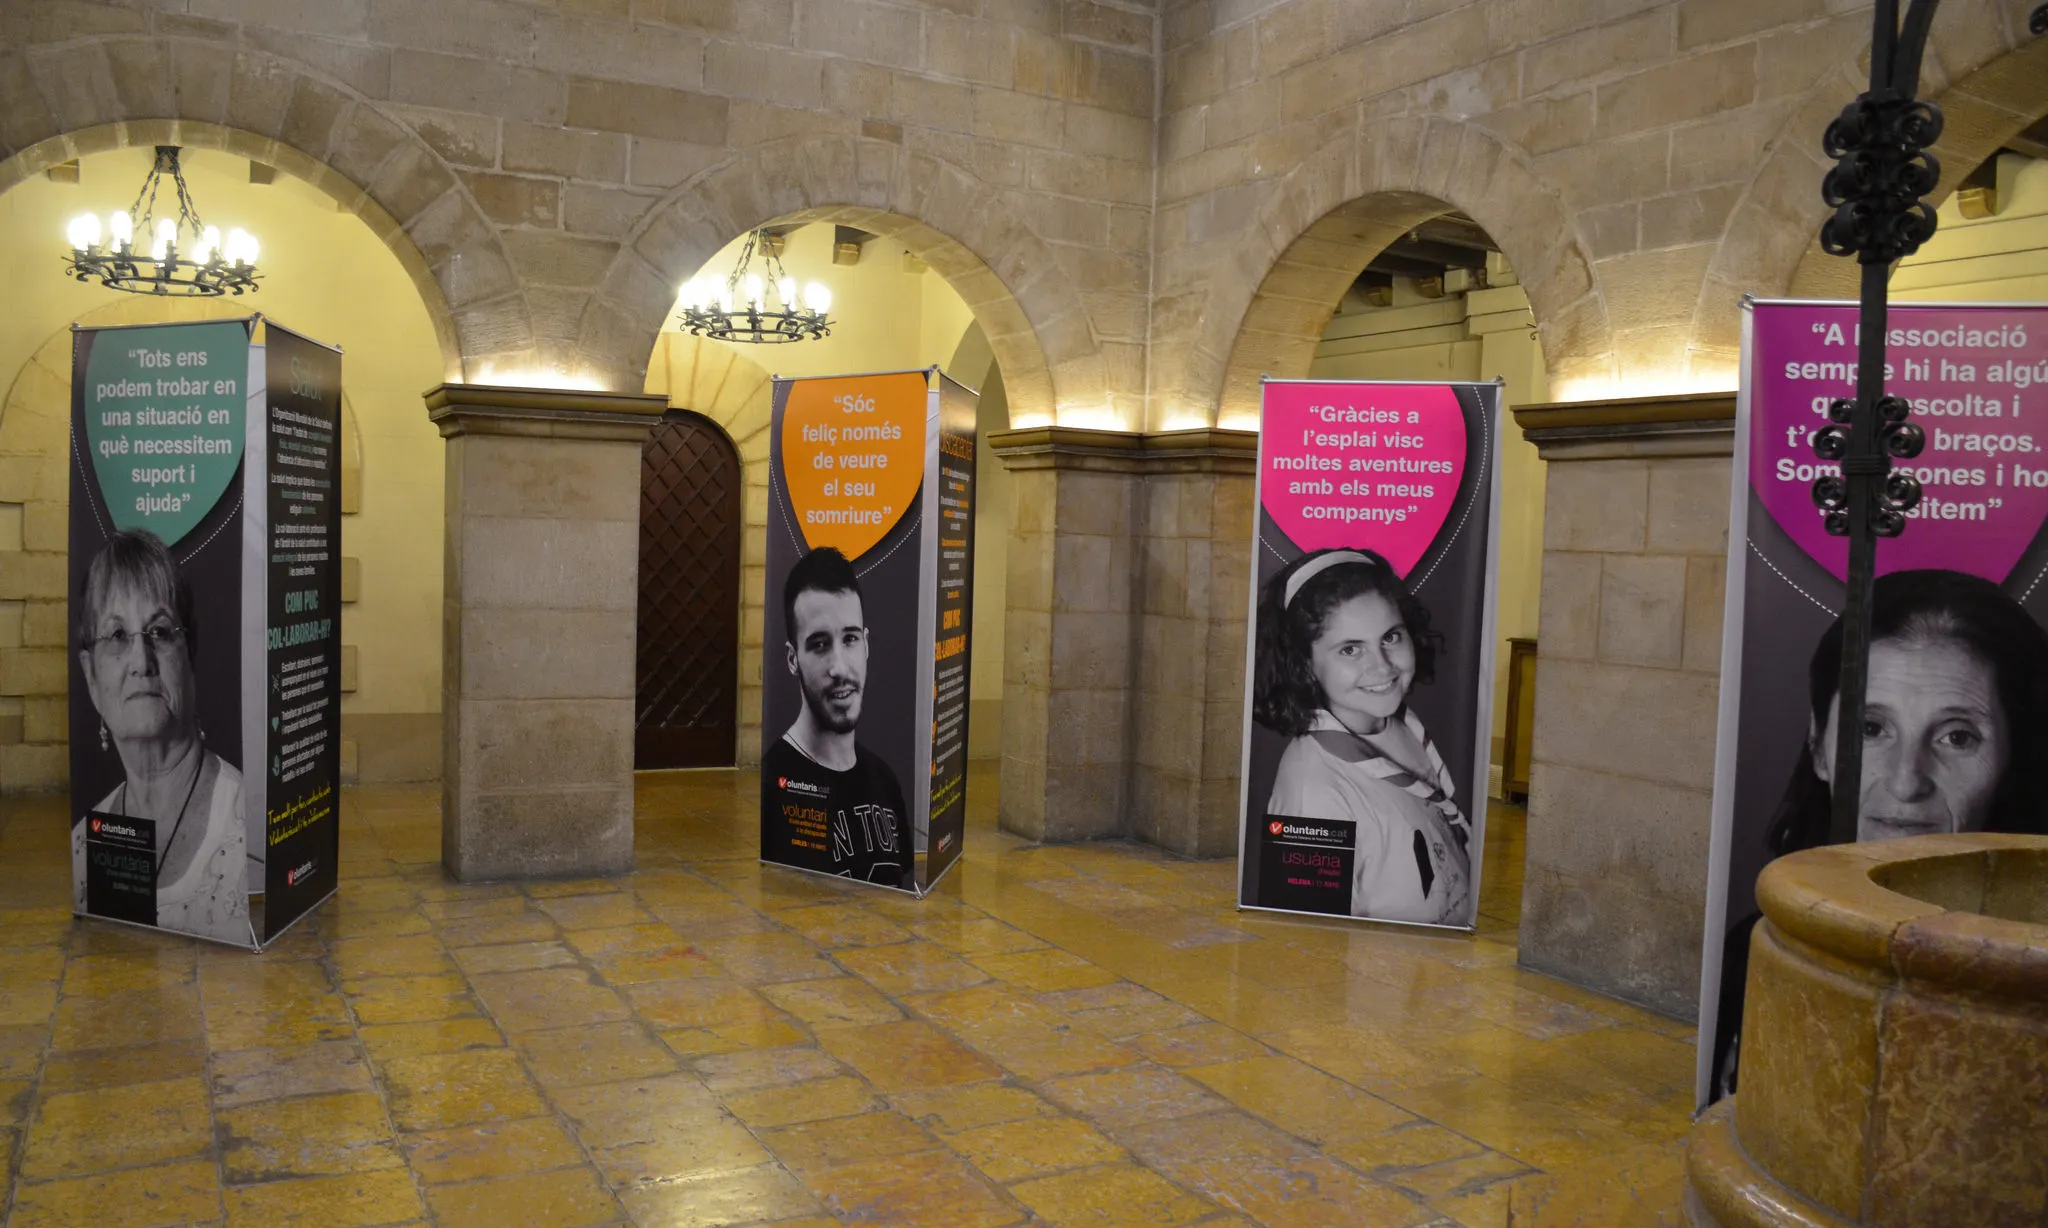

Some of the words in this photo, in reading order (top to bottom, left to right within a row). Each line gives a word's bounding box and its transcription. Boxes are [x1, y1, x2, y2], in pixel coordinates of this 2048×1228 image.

[1811, 323, 1845, 346] “A
[128, 349, 171, 368] “Tots
[177, 350, 208, 366] ens
[290, 356, 322, 401] Salut
[1785, 361, 1895, 387] sempe
[1905, 358, 1930, 382] hi
[1940, 359, 1976, 382] ha
[97, 380, 152, 402] podem
[156, 376, 209, 397] trobar
[214, 378, 237, 395] en
[834, 392, 876, 415] “Sóc
[1309, 405, 1401, 424] “Gràcies
[1407, 411, 1419, 424] a
[2012, 394, 2021, 418] i
[102, 410, 132, 426] una
[137, 405, 202, 426] situació
[208, 407, 230, 424] en
[802, 423, 838, 446] feliç
[842, 420, 902, 441] només
[1384, 431, 1424, 450] visc
[1934, 428, 2042, 458] braços.
[99, 434, 129, 458] què
[134, 433, 232, 455] necessitem
[813, 452, 835, 470] de
[839, 454, 889, 469] veure
[1273, 454, 1342, 471] moltes
[1349, 456, 1453, 474] aventures
[1776, 458, 1841, 482] Som
[1996, 463, 2004, 486] i
[131, 464, 186, 486] suport
[190, 464, 196, 484] i
[823, 479, 839, 497] el
[844, 482, 875, 497] seu
[1289, 478, 1334, 495] amb
[1340, 479, 1370, 497] els
[1377, 482, 1435, 499] meus
[135, 492, 191, 516] ajuda”
[805, 504, 893, 525] somriure”
[1302, 504, 1418, 526] companys”
[285, 591, 303, 614] COM
[1282, 850, 1341, 868] usuària
